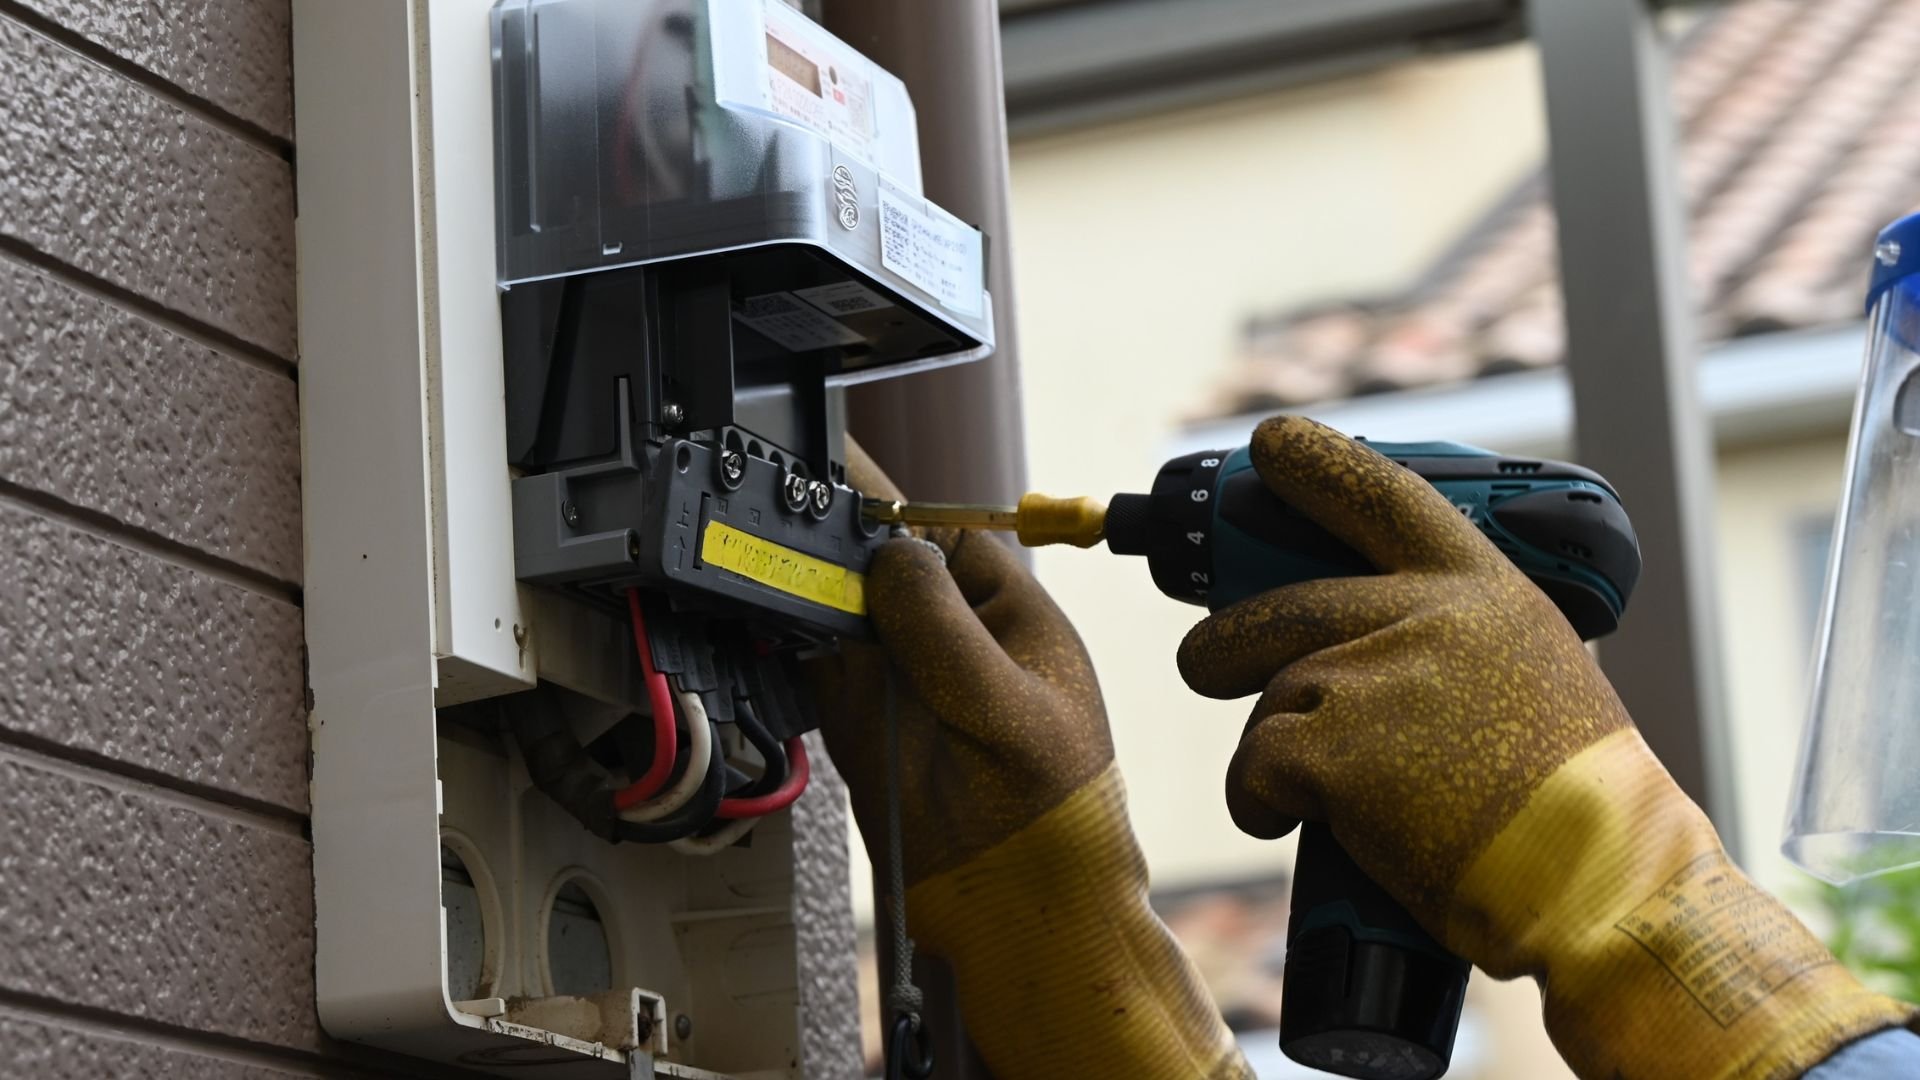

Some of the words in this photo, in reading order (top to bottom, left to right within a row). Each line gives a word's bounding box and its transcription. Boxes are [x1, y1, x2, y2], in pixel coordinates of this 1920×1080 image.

[1200, 458, 1219, 468] 8
[1191, 489, 1209, 502] 6
[1187, 531, 1205, 545] 4
[1191, 571, 1209, 583] 2
